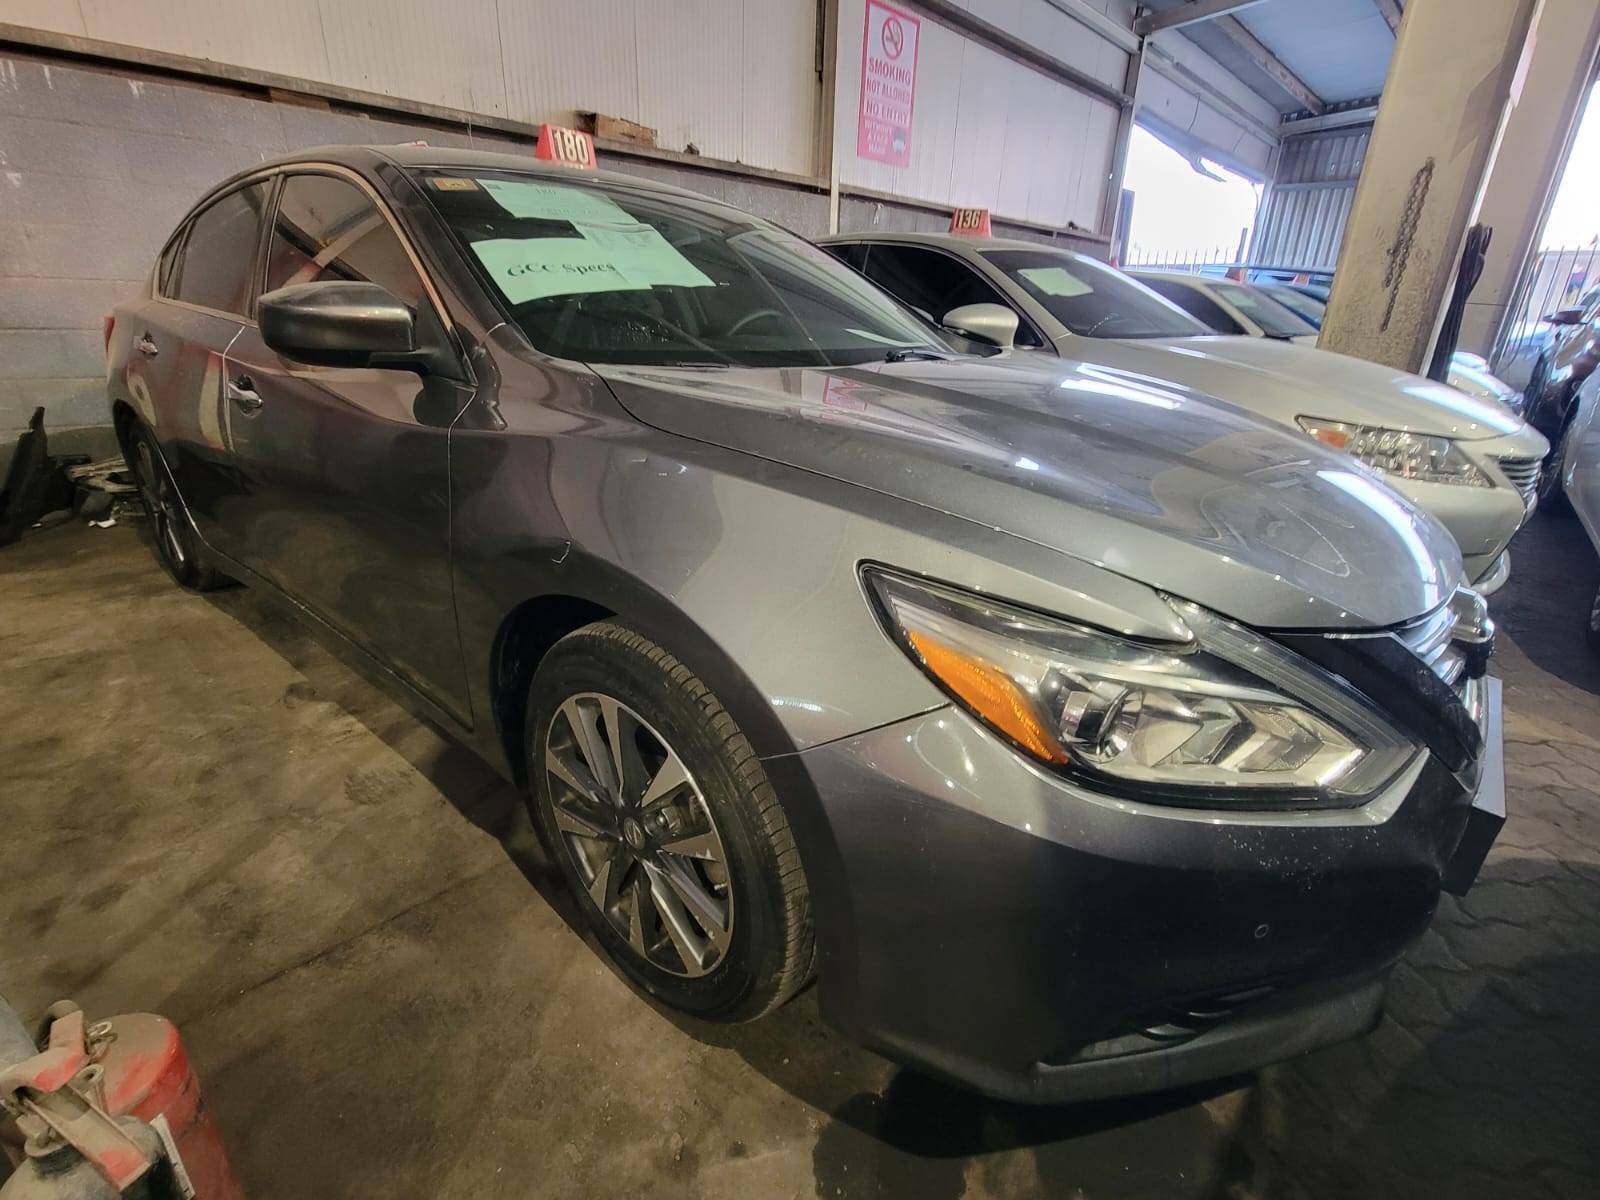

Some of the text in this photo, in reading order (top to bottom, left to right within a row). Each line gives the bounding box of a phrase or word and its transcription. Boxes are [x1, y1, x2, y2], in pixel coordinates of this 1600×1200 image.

[868, 57, 911, 86] SMOKING
[866, 77, 880, 95] NOT
[866, 99, 880, 116] NO
[553, 128, 589, 164] 180
[957, 208, 980, 229] 136
[506, 262, 616, 277] GCC Specs
